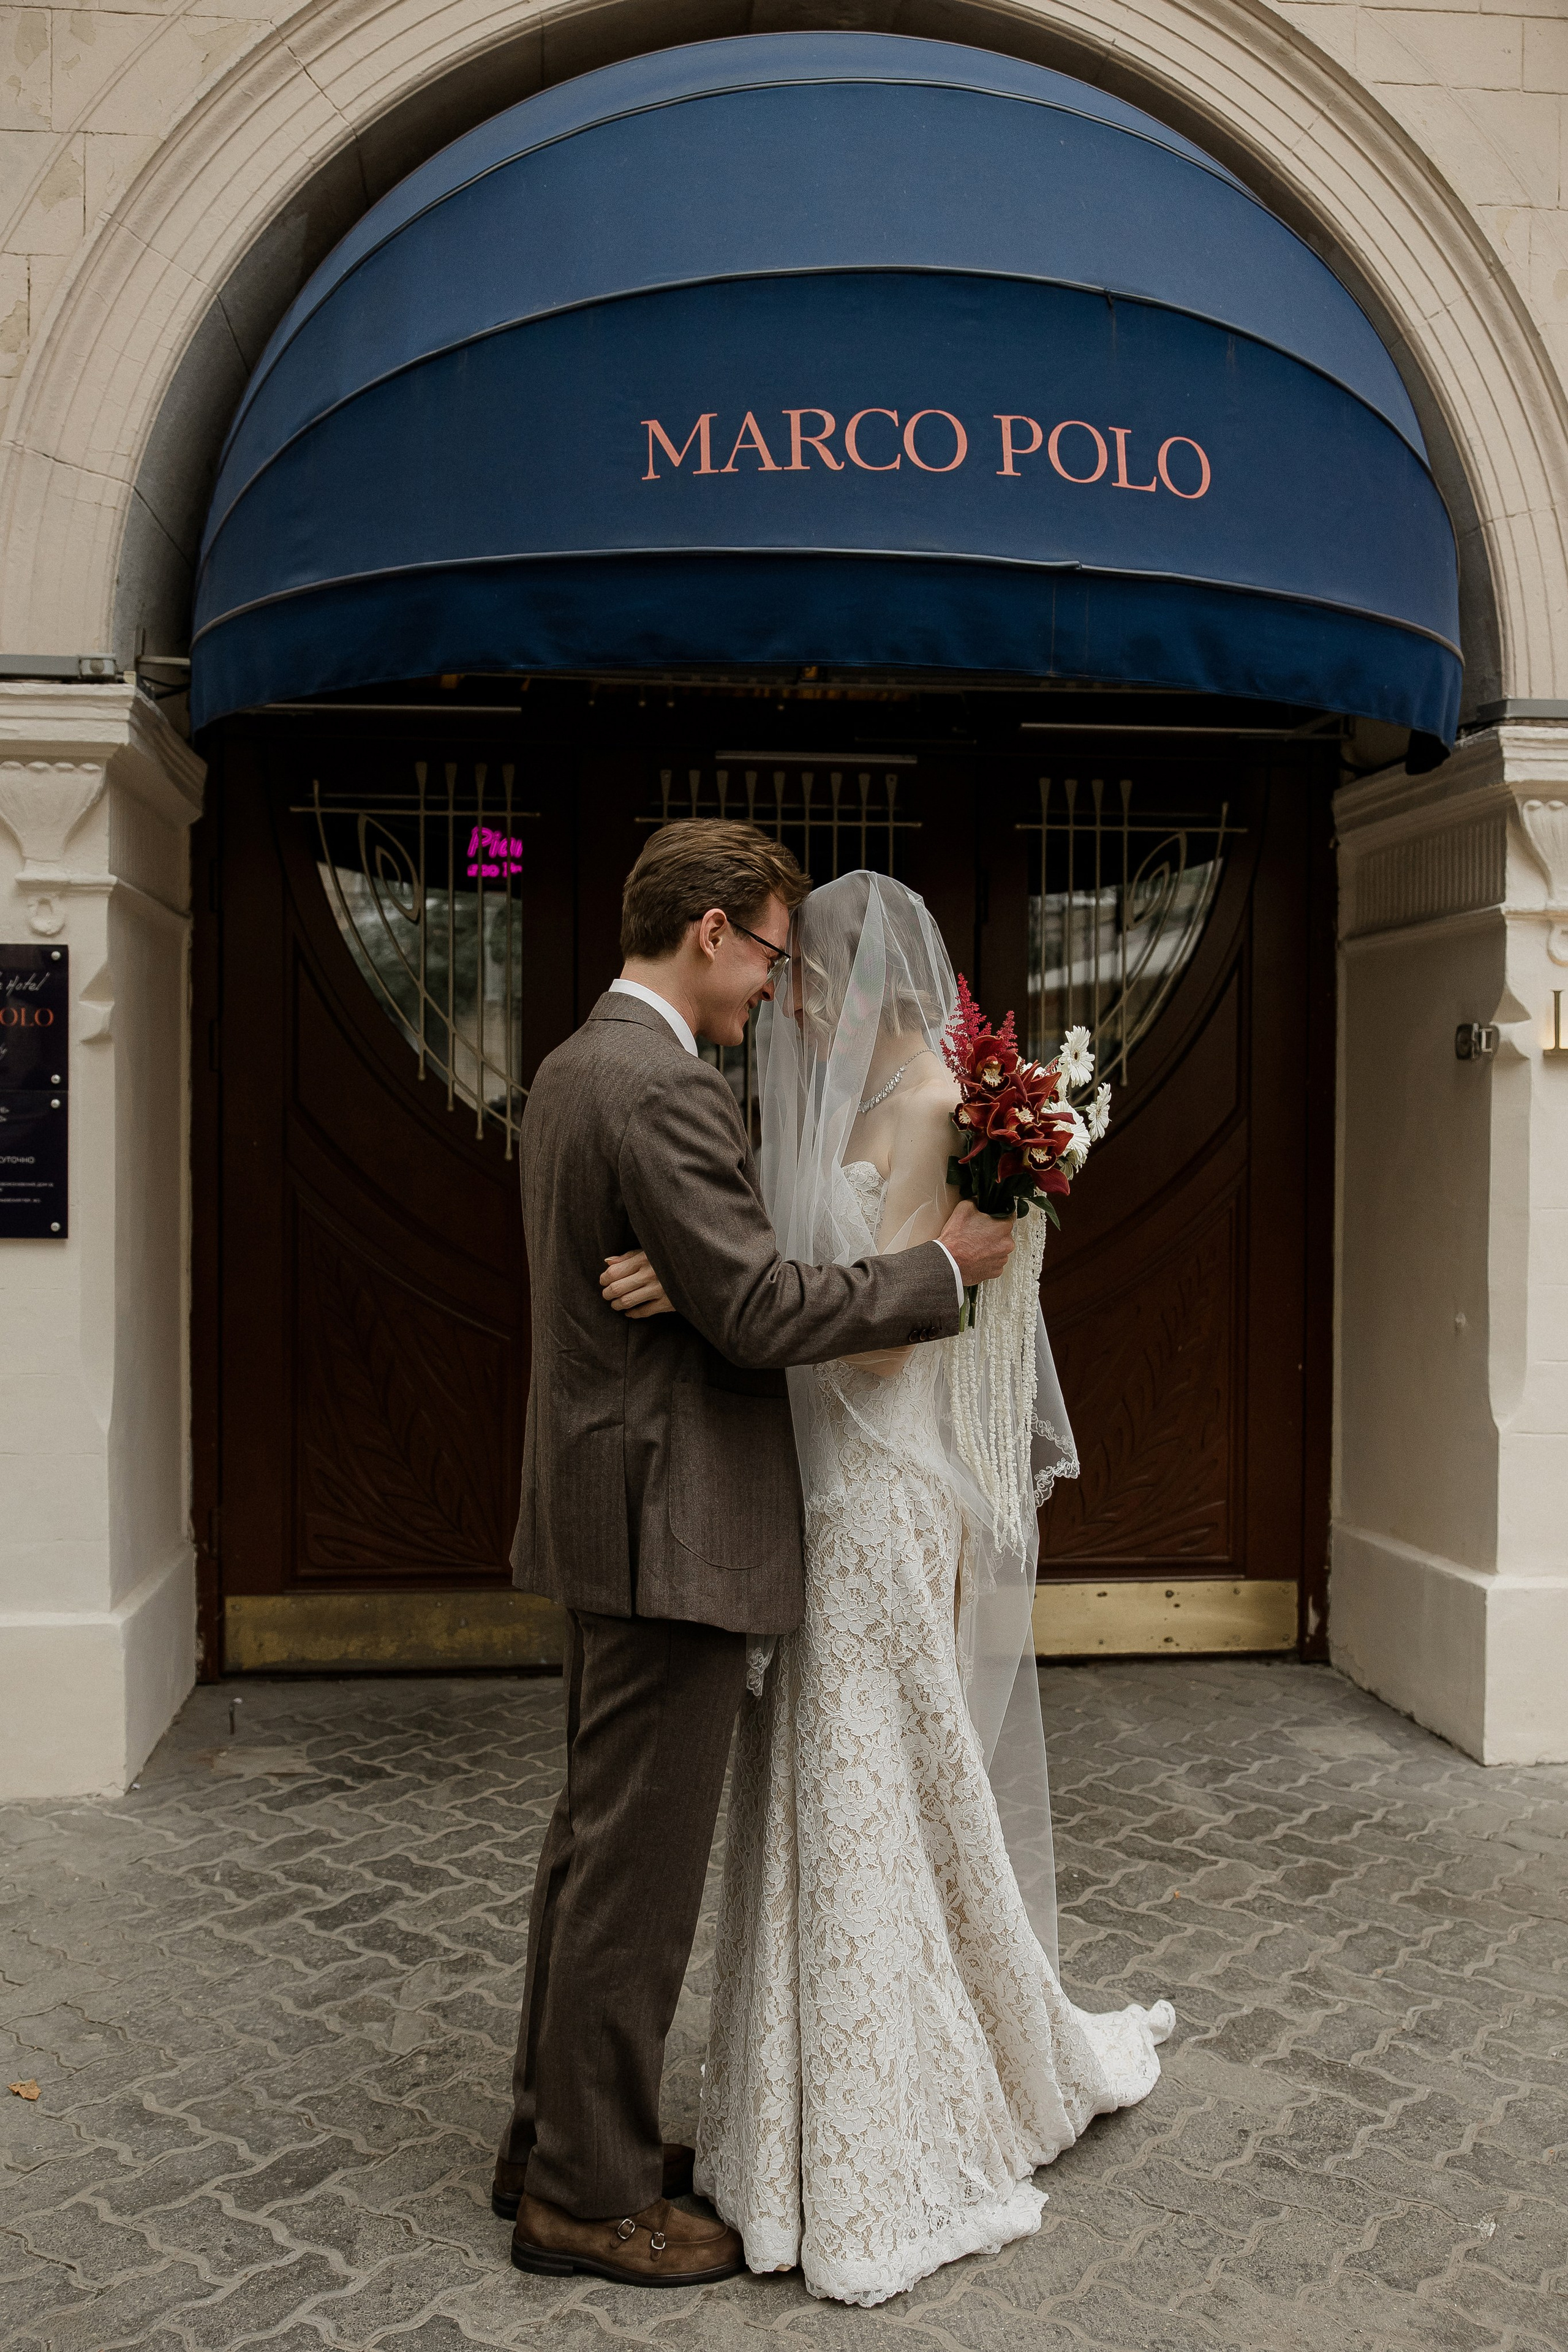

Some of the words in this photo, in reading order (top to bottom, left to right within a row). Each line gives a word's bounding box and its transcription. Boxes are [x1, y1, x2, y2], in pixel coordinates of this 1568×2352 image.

[640, 408, 968, 480] MARCO
[993, 415, 1211, 499] POLO
[6, 972, 50, 997] Hotel
